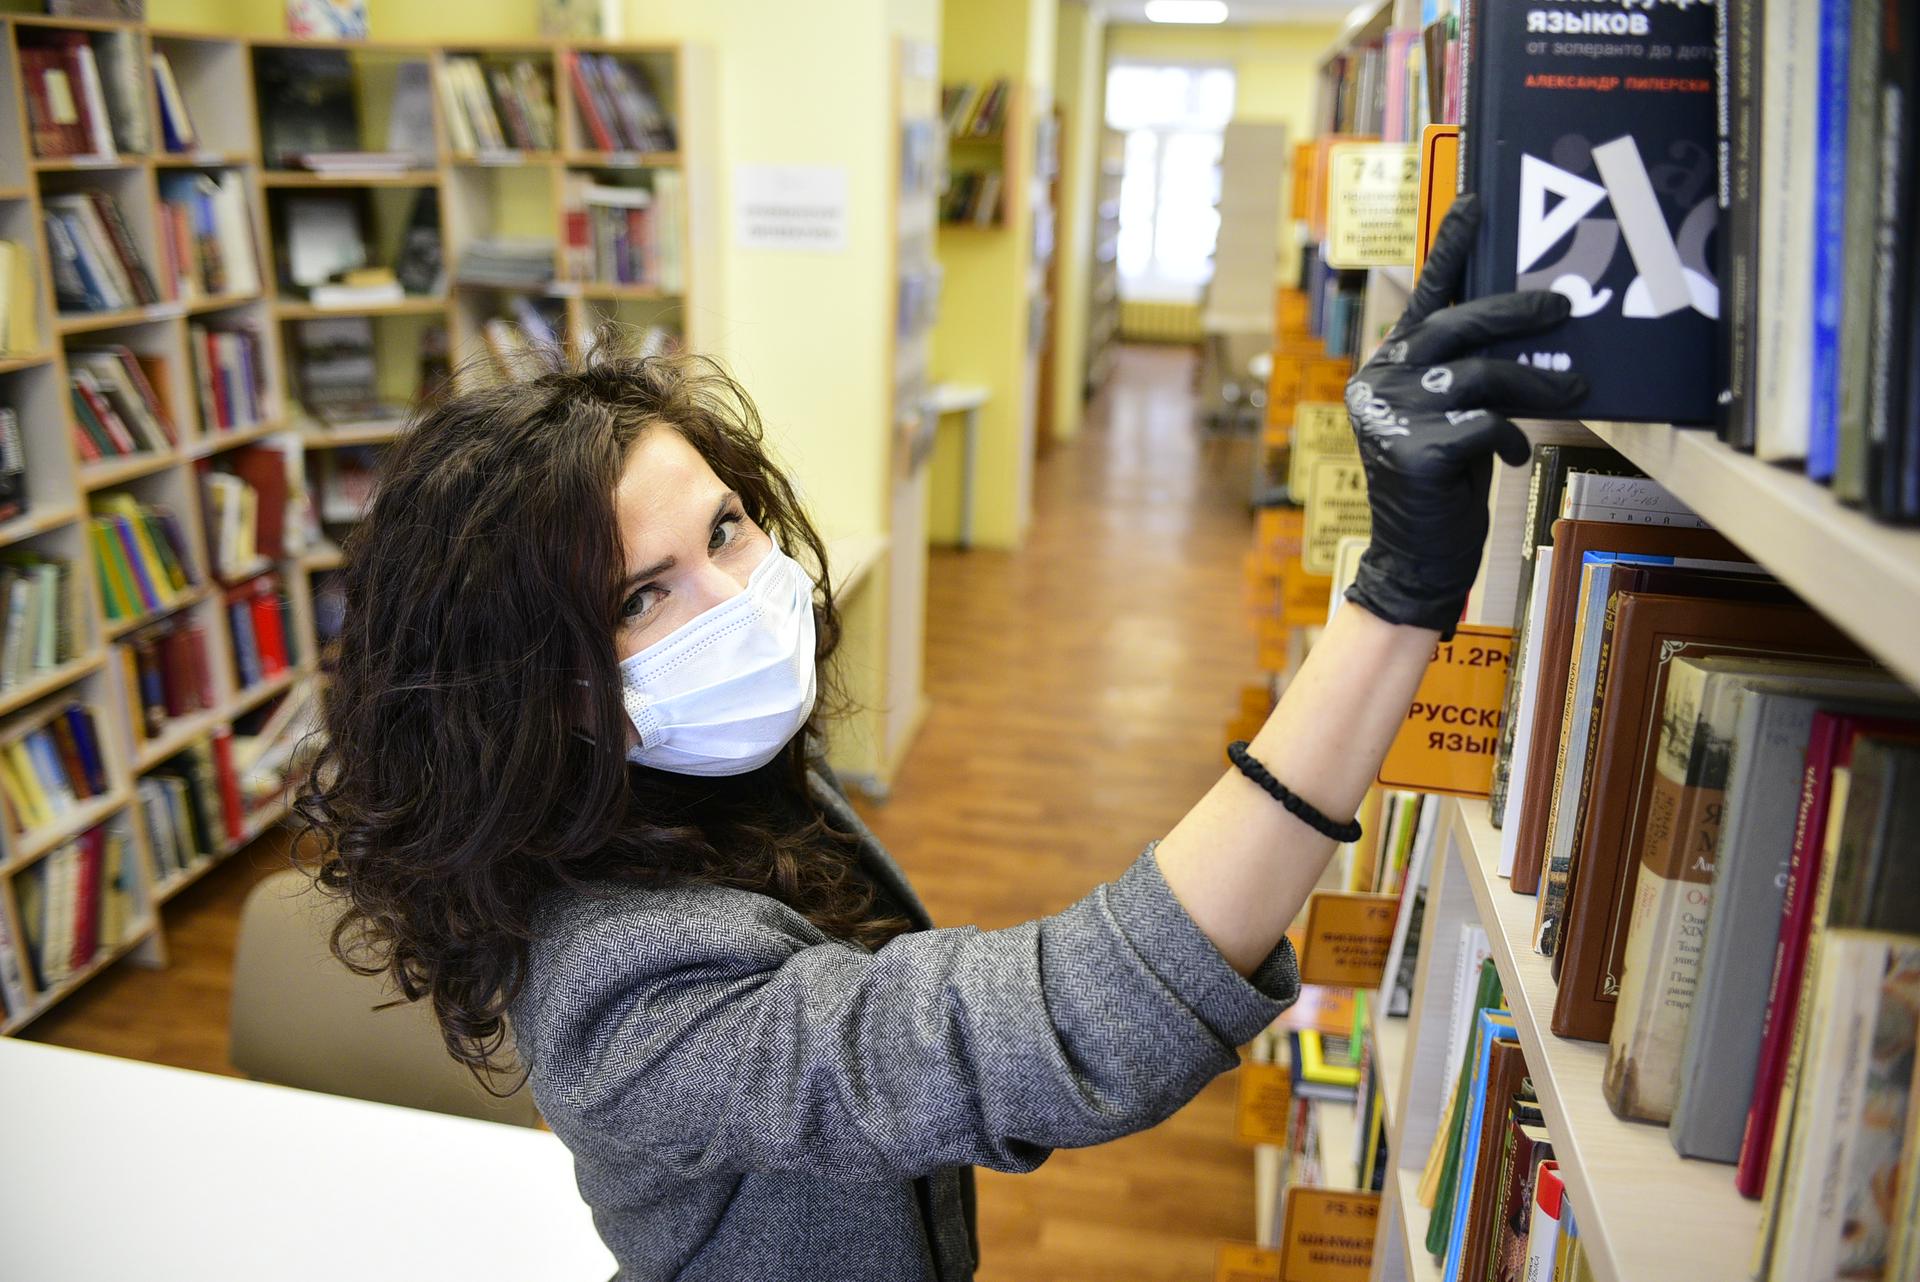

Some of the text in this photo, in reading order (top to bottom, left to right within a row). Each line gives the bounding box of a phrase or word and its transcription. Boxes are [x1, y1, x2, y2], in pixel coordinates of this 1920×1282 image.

[1526, 11, 1649, 35] языков
[1527, 42, 1548, 55] от
[1552, 43, 1643, 58] эсперанто
[1649, 45, 1672, 60] до
[1525, 75, 1620, 92] АЛЕКСАНДР
[1596, 641, 1610, 698] речи
[1564, 661, 1578, 721] ПРАКТИКУМ
